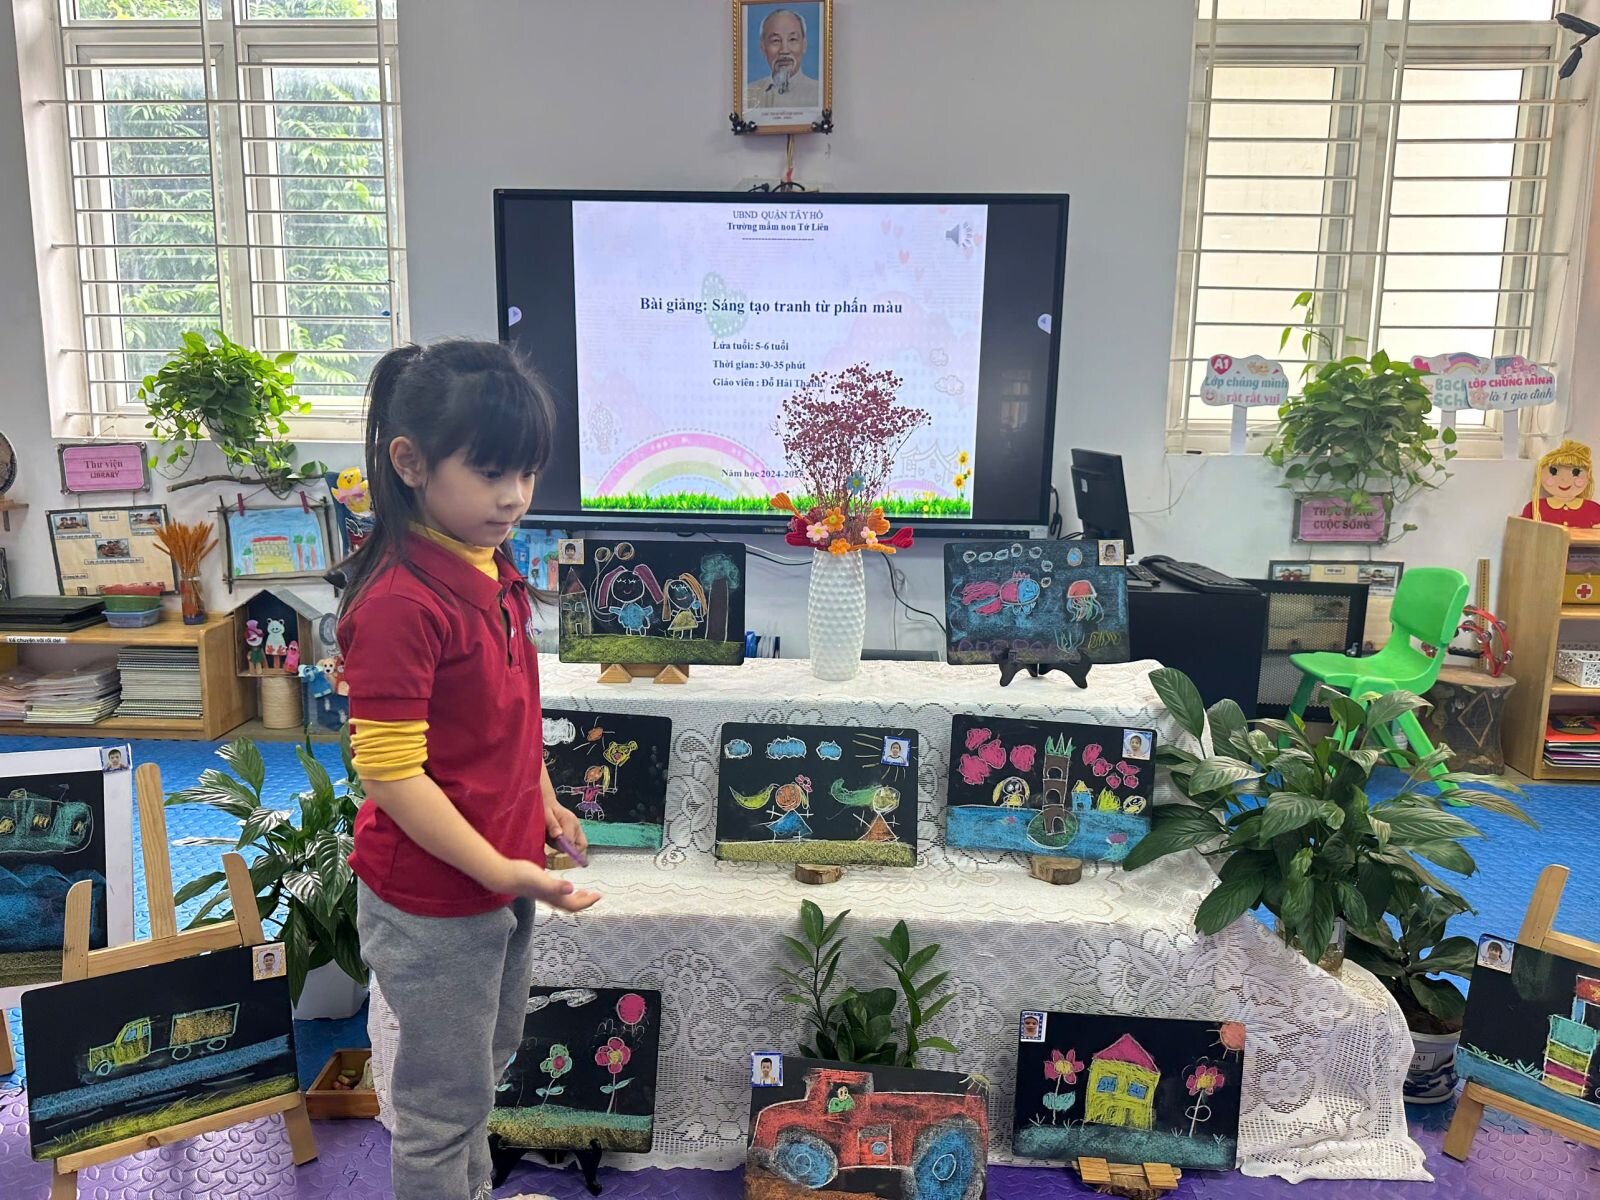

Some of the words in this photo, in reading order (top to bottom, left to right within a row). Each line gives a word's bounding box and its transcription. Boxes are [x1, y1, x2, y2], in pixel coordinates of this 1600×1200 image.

[732, 210, 758, 219] UBND
[761, 209, 787, 220] QUẬN
[789, 210, 809, 219] TÂY
[809, 209, 824, 219] HỒ
[727, 222, 758, 232] Trường
[759, 221, 779, 231] mầm
[811, 223, 829, 231] Liên
[640, 297, 663, 310] Bài
[666, 298, 708, 314] giảng:
[711, 299, 745, 315] Sáng
[749, 300, 770, 315] tạo
[774, 300, 811, 313] tranh
[815, 300, 831, 313] từ
[834, 297, 867, 316] phấn
[872, 301, 903, 313] màu
[713, 341, 731, 350] Lứa
[733, 338, 754, 350] tuổi:
[755, 342, 770, 350] 5-6
[771, 339, 789, 351] tuổi
[713, 360, 734, 369] Thời
[735, 361, 759, 371] gian:
[759, 361, 784, 369] 30-35
[785, 361, 806, 371] phút
[1214, 359, 1230, 369] A1
[713, 377, 734, 386] Giáo
[735, 378, 755, 387] viên
[761, 376, 775, 387] Đỗ
[776, 378, 793, 387] Hải
[1205, 376, 1225, 389] Lớp
[1226, 376, 1259, 390] chúng
[1261, 377, 1288, 388] mình
[1468, 377, 1486, 389] LỚP
[1264, 394, 1280, 403] vui
[84, 460, 103, 469] Thư
[105, 459, 123, 470] viện
[90, 470, 120, 479] LIBRARY
[721, 468, 742, 478] Năm
[744, 469, 759, 479] học
[1313, 519, 1341, 532] CUỘC
[1342, 518, 1371, 530] SỐNG
